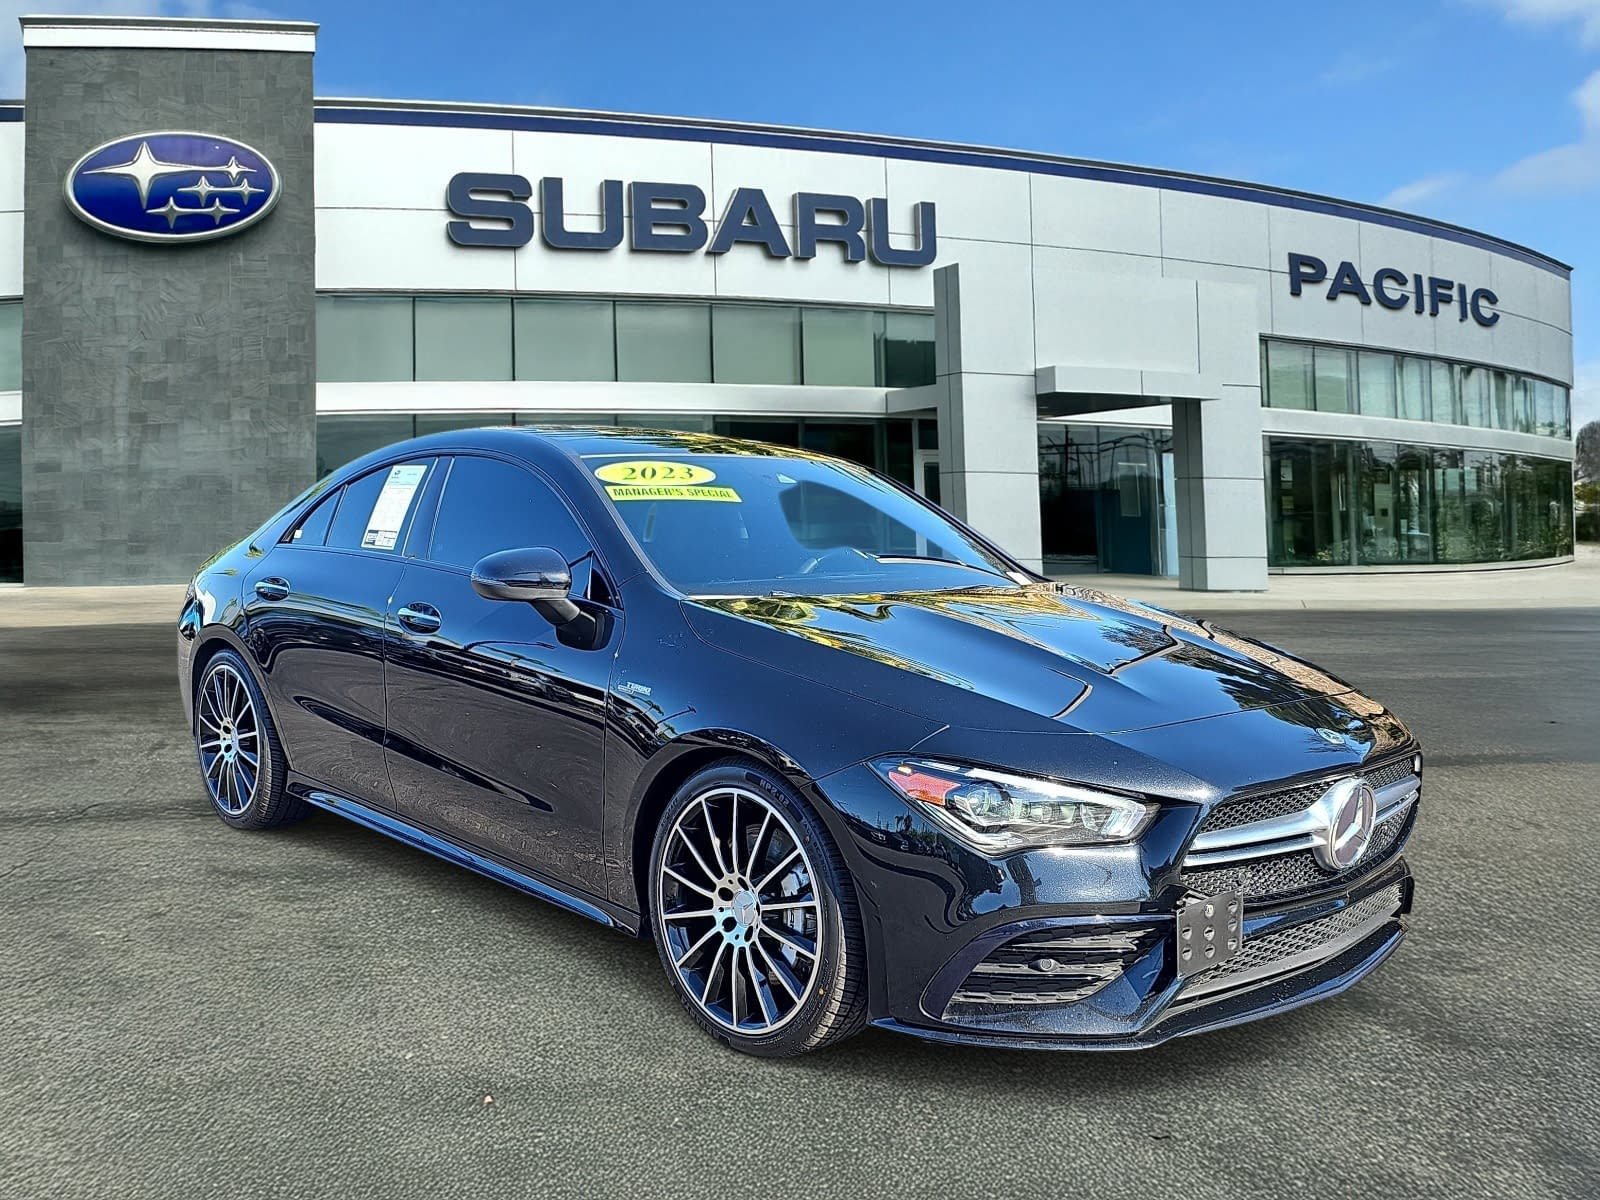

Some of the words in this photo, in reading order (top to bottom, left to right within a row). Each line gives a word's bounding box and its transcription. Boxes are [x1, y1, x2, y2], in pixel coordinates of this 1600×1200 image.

[447, 172, 937, 267] SUBARU
[1288, 252, 1500, 327] PACIFIC
[612, 487, 684, 497] MANAGER'S
[686, 488, 734, 498] SPECIAL
[622, 466, 694, 480] 2023
